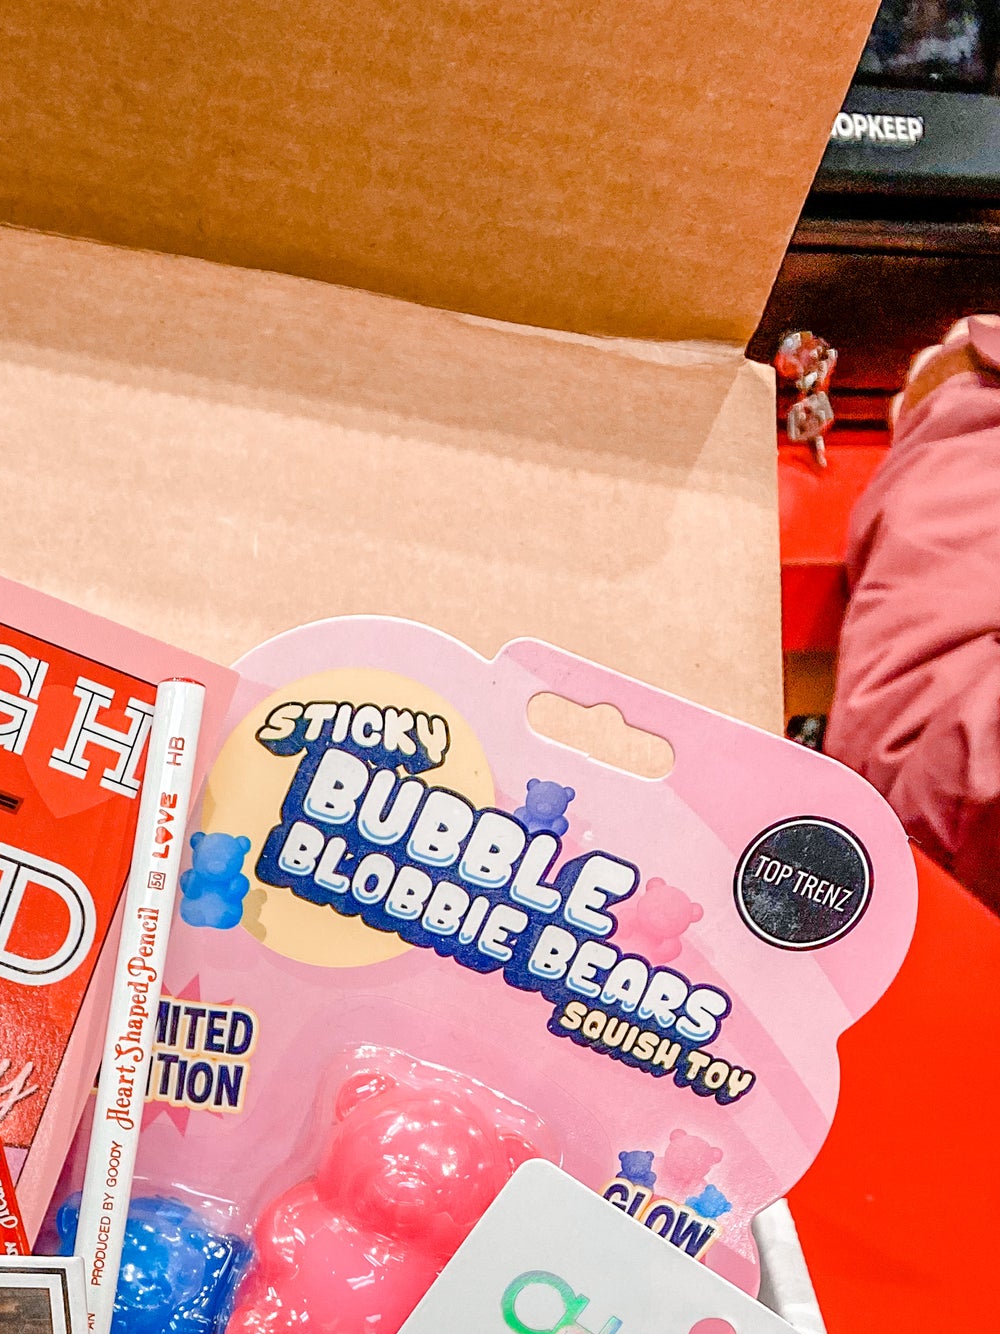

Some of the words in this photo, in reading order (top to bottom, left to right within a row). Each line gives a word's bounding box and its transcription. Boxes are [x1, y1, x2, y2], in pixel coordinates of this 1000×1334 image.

[831, 112, 924, 142] OPKEEP
[166, 735, 185, 766] HB
[258, 702, 450, 766] STICKY
[303, 747, 639, 938] BUBBLE
[754, 855, 793, 886] TOP
[792, 870, 855, 912] TRENZ
[127, 907, 160, 983] Pencil
[277, 820, 531, 963] BLOBBIE
[527, 925, 731, 1045] BEARS
[114, 981, 149, 1063] Shaped
[559, 1002, 682, 1072] SQUISH
[687, 1051, 754, 1102] TOY
[105, 1064, 136, 1131] Heart
[146, 1053, 244, 1107] TION
[107, 1140, 123, 1188] GOODY
[102, 1192, 114, 1211] BY
[91, 1215, 111, 1287] PRODUCED
